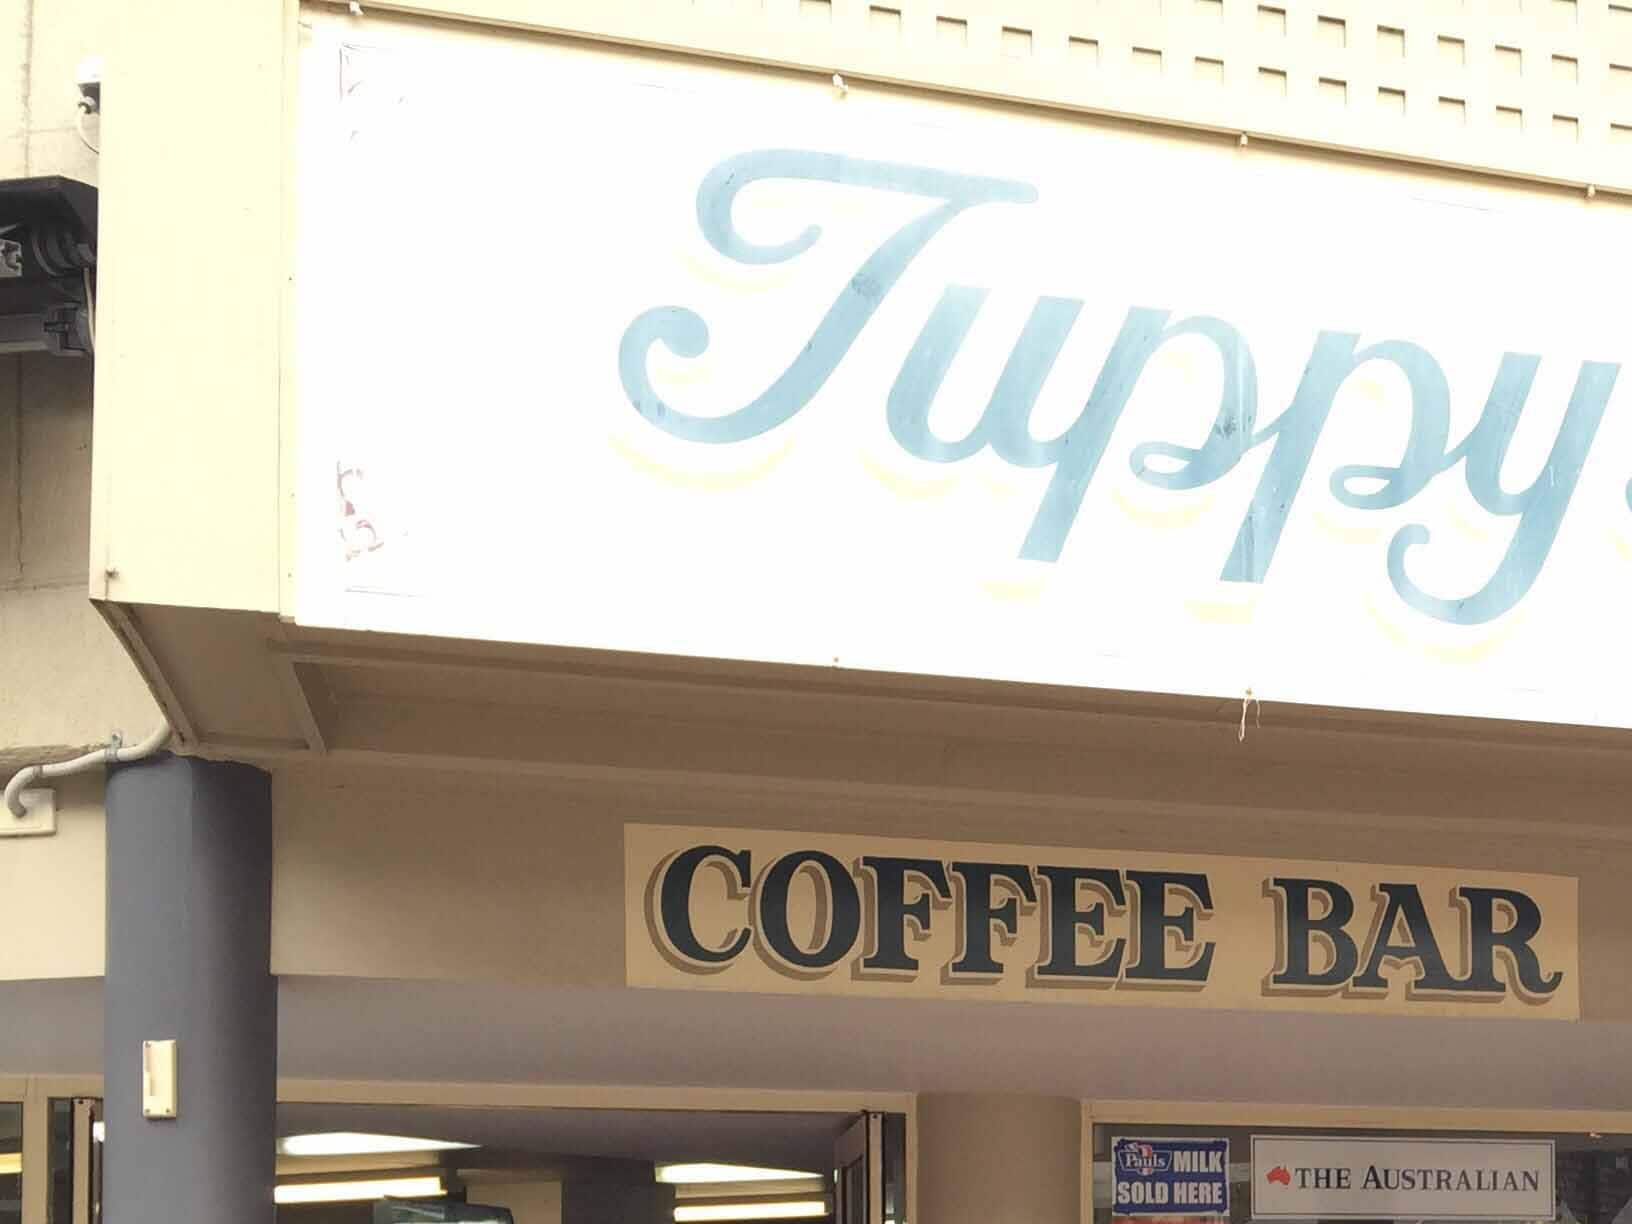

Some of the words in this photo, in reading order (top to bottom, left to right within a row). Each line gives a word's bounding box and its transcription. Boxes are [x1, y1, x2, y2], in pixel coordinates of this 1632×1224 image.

[648, 844, 1215, 988] COFFEE
[1265, 876, 1564, 1002] BAR
[1125, 1154, 1166, 1169] Pauls
[1173, 1151, 1224, 1173] MILK
[1294, 1167, 1352, 1190] THE
[1361, 1165, 1540, 1192] AUSTRALIAN
[1117, 1182, 1169, 1204] SOLD
[1174, 1183, 1223, 1204] HERE
